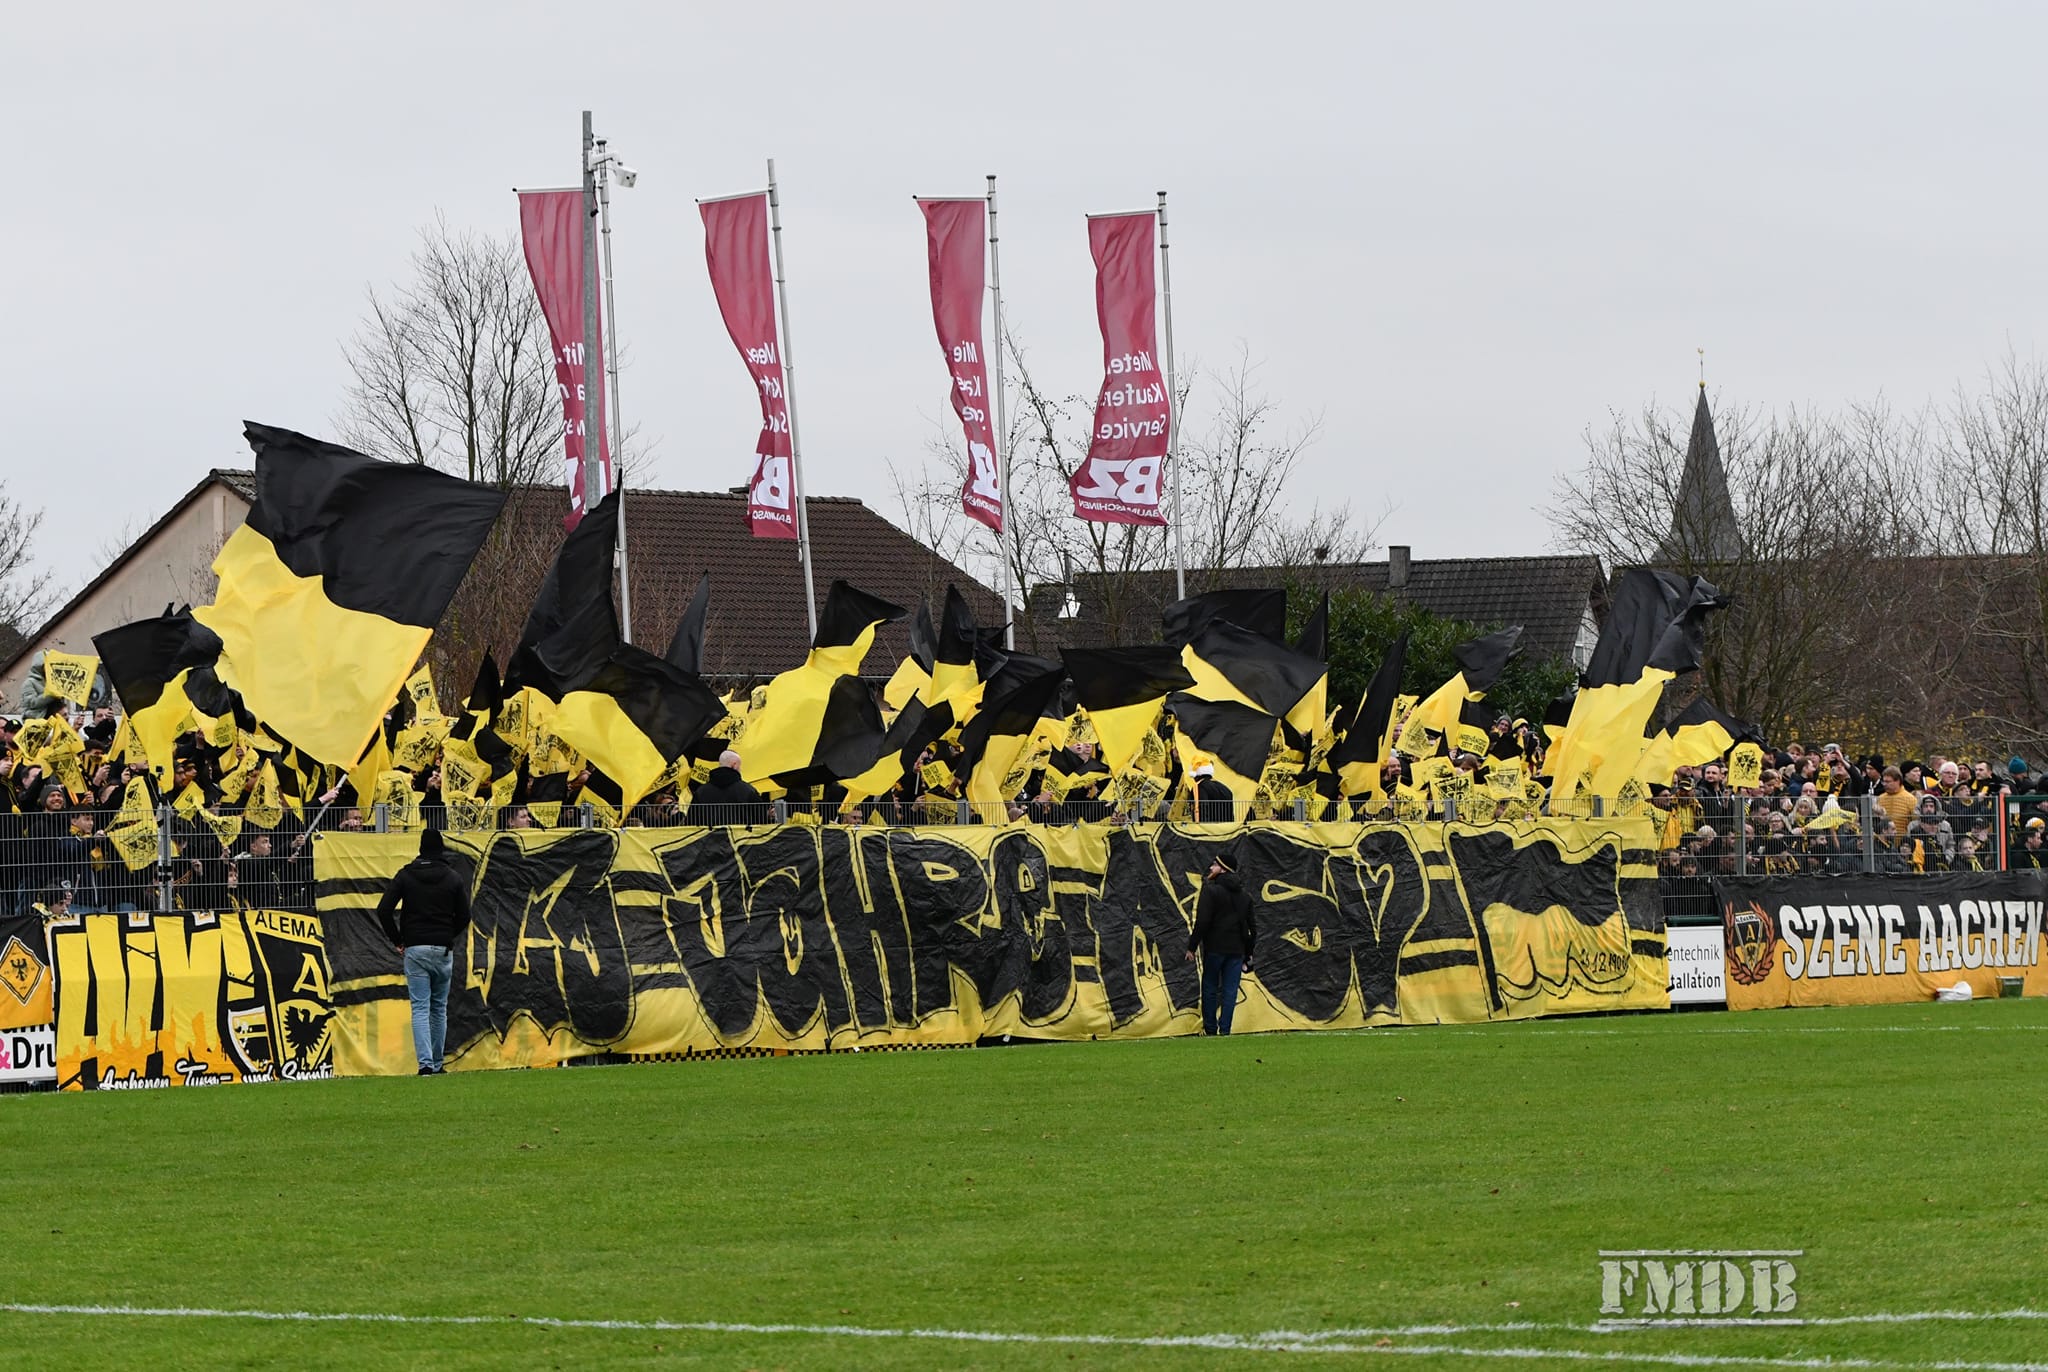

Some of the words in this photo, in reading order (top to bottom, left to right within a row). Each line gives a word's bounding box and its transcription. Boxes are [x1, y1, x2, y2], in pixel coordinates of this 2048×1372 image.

[255, 910, 318, 939] ALEMA
[1779, 903, 1906, 980] SZENE
[1917, 899, 2044, 973] AACHEN
